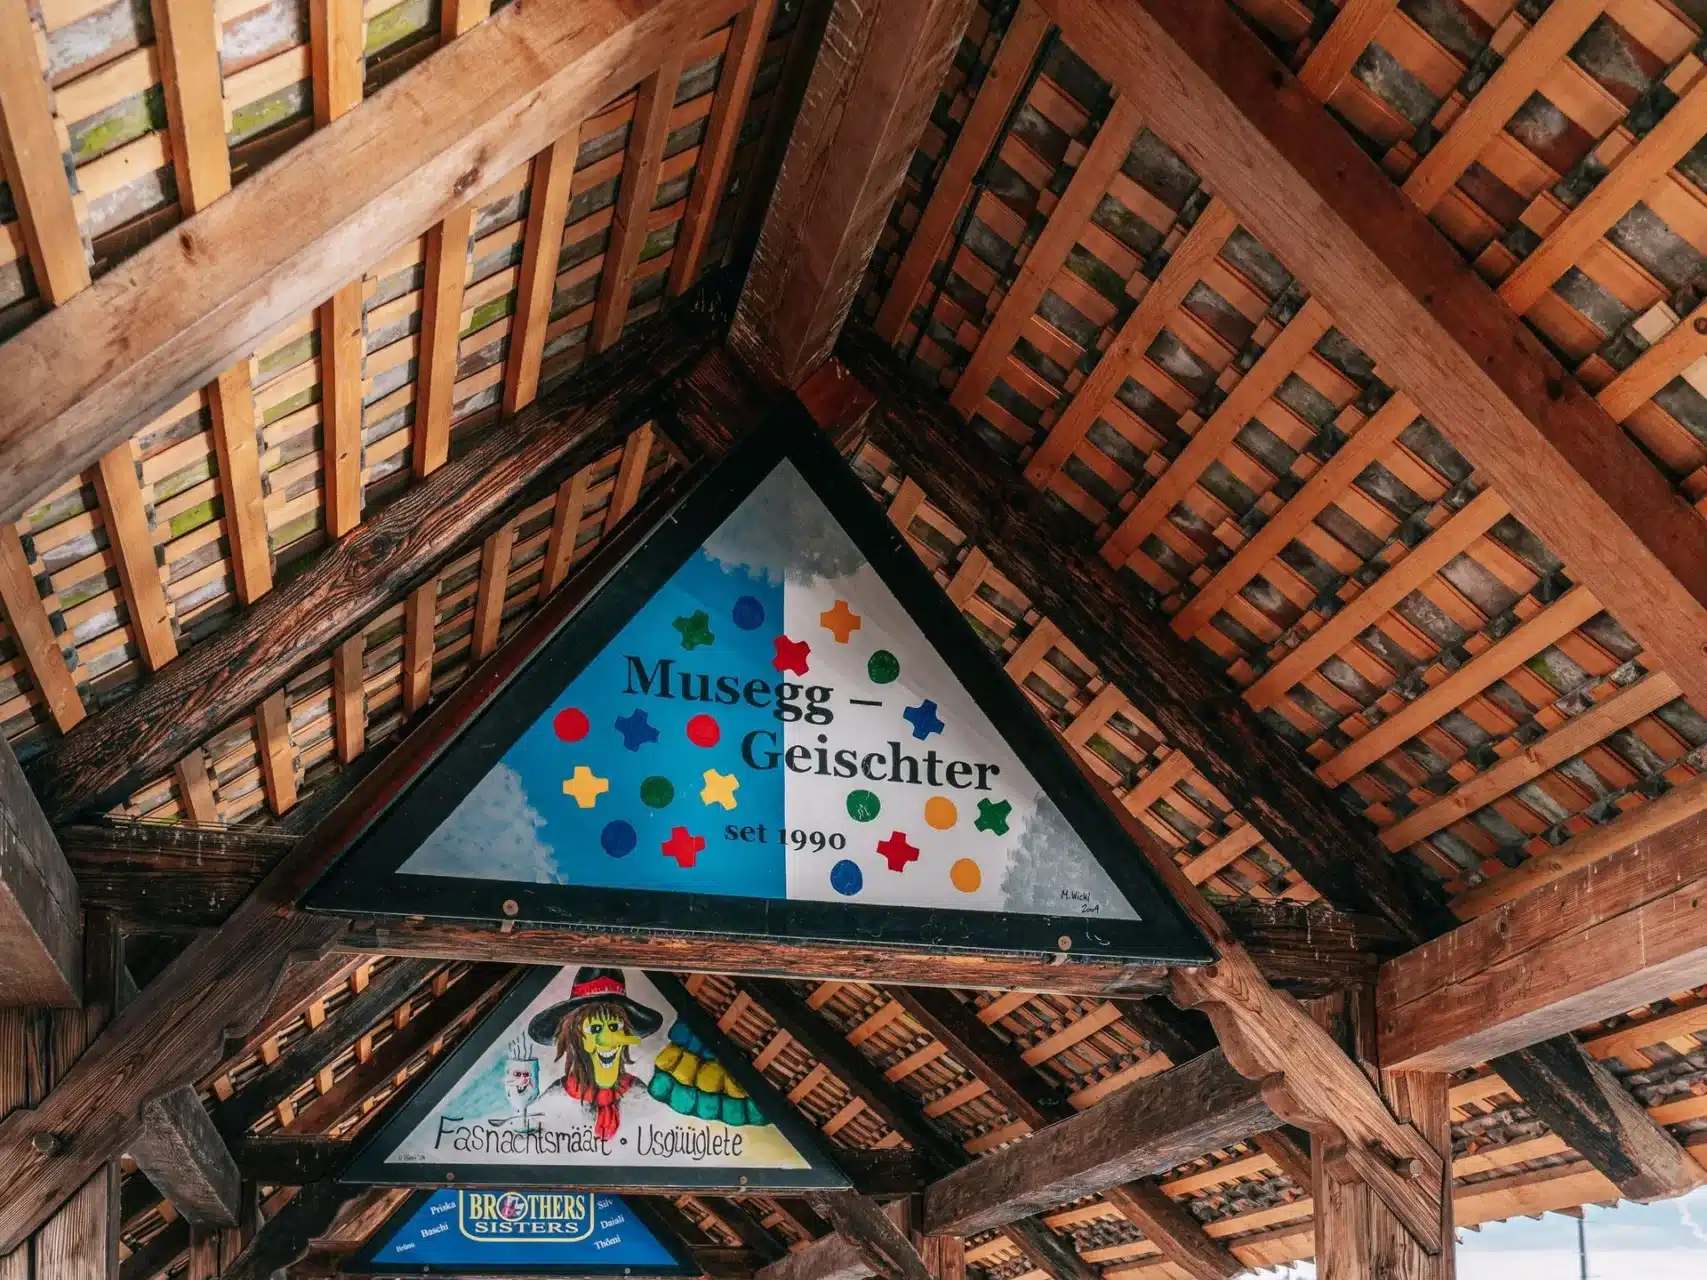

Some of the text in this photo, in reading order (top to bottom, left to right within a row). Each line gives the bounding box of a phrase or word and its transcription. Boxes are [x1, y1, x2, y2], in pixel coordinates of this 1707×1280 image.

[621, 654, 834, 726] Musegg
[741, 730, 1000, 791] Geischter
[724, 823, 847, 853] set 1990
[434, 1115, 743, 1161] Fasnachtsmäärt Usgüüglete
[430, 1201, 456, 1216] Priska
[469, 1191, 586, 1222] BROTHERS
[420, 1221, 449, 1238] Baschi
[475, 1221, 579, 1234] SISTERS
